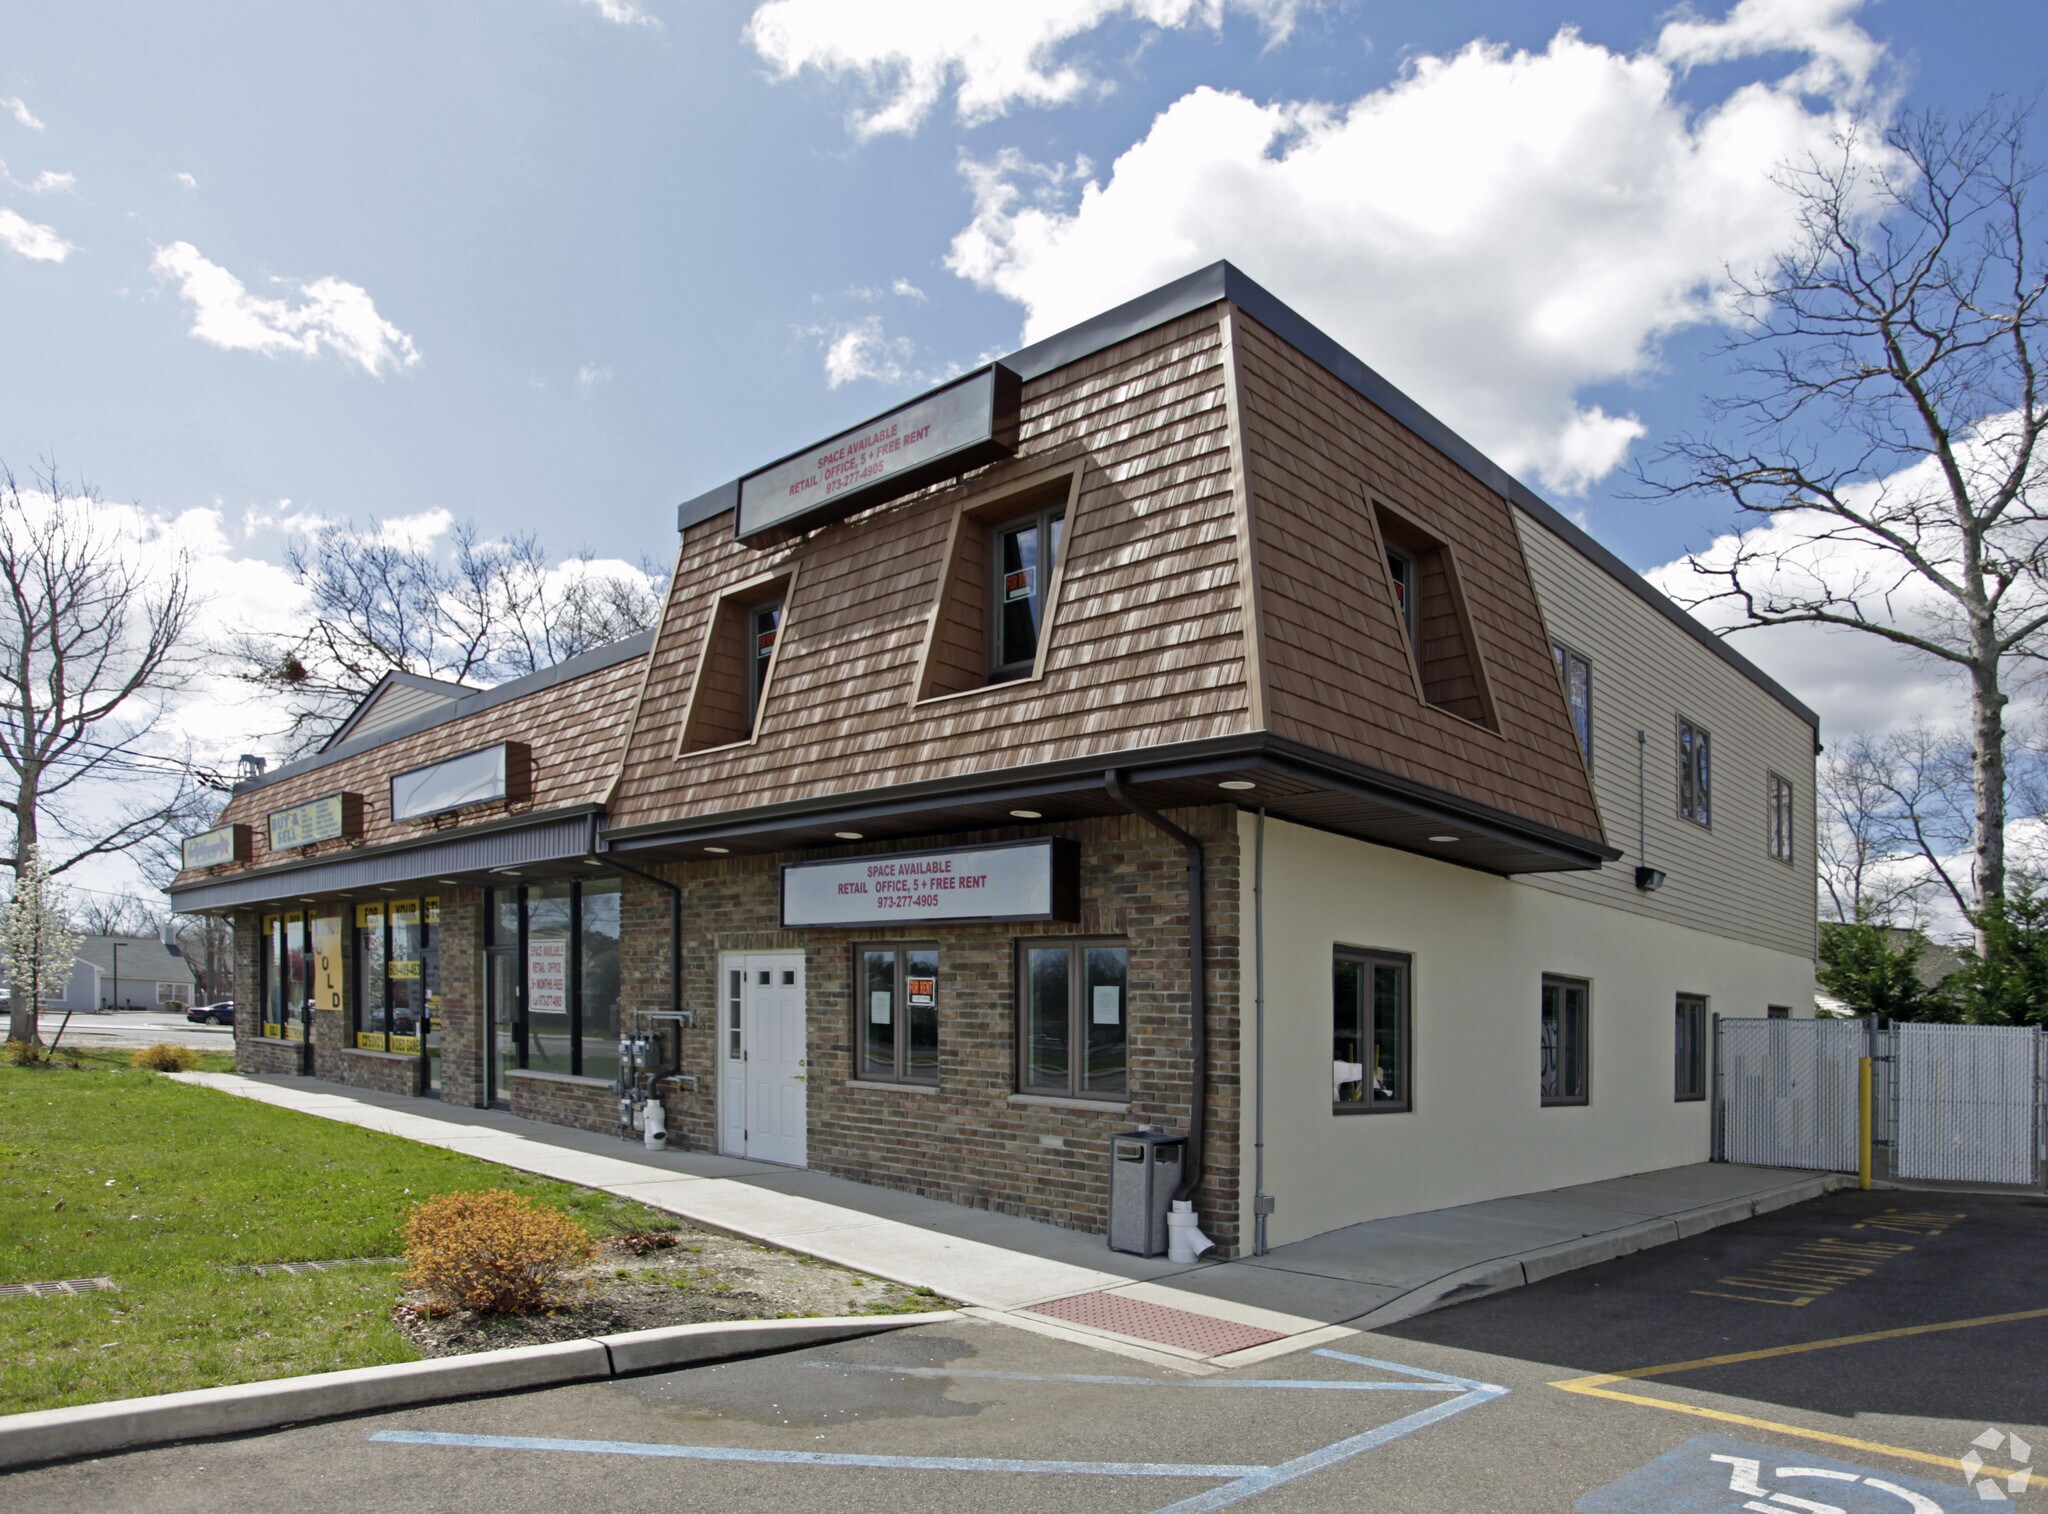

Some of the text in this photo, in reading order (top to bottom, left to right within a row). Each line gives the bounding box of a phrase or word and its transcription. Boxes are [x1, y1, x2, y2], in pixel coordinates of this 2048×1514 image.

[818, 424, 898, 469] SPACE AVAILABLE
[789, 475, 818, 496] RETAIL
[824, 458, 859, 483] OFFICE,
[861, 452, 867, 466] 5
[876, 440, 901, 460] FREE
[903, 425, 930, 446] RENT
[826, 460, 884, 494] 973-277-4905
[272, 815, 289, 831] BUY
[277, 827, 296, 844] SELL
[867, 860, 951, 878] SPACE AVAILABLE
[838, 881, 868, 895] RETAIL
[875, 879, 911, 894] OFFICE,
[913, 878, 919, 891] 5
[930, 876, 956, 890] FREE
[958, 875, 987, 889] RENT
[877, 893, 938, 909] 973-277-4905
[909, 980, 933, 995] FOR RENT
